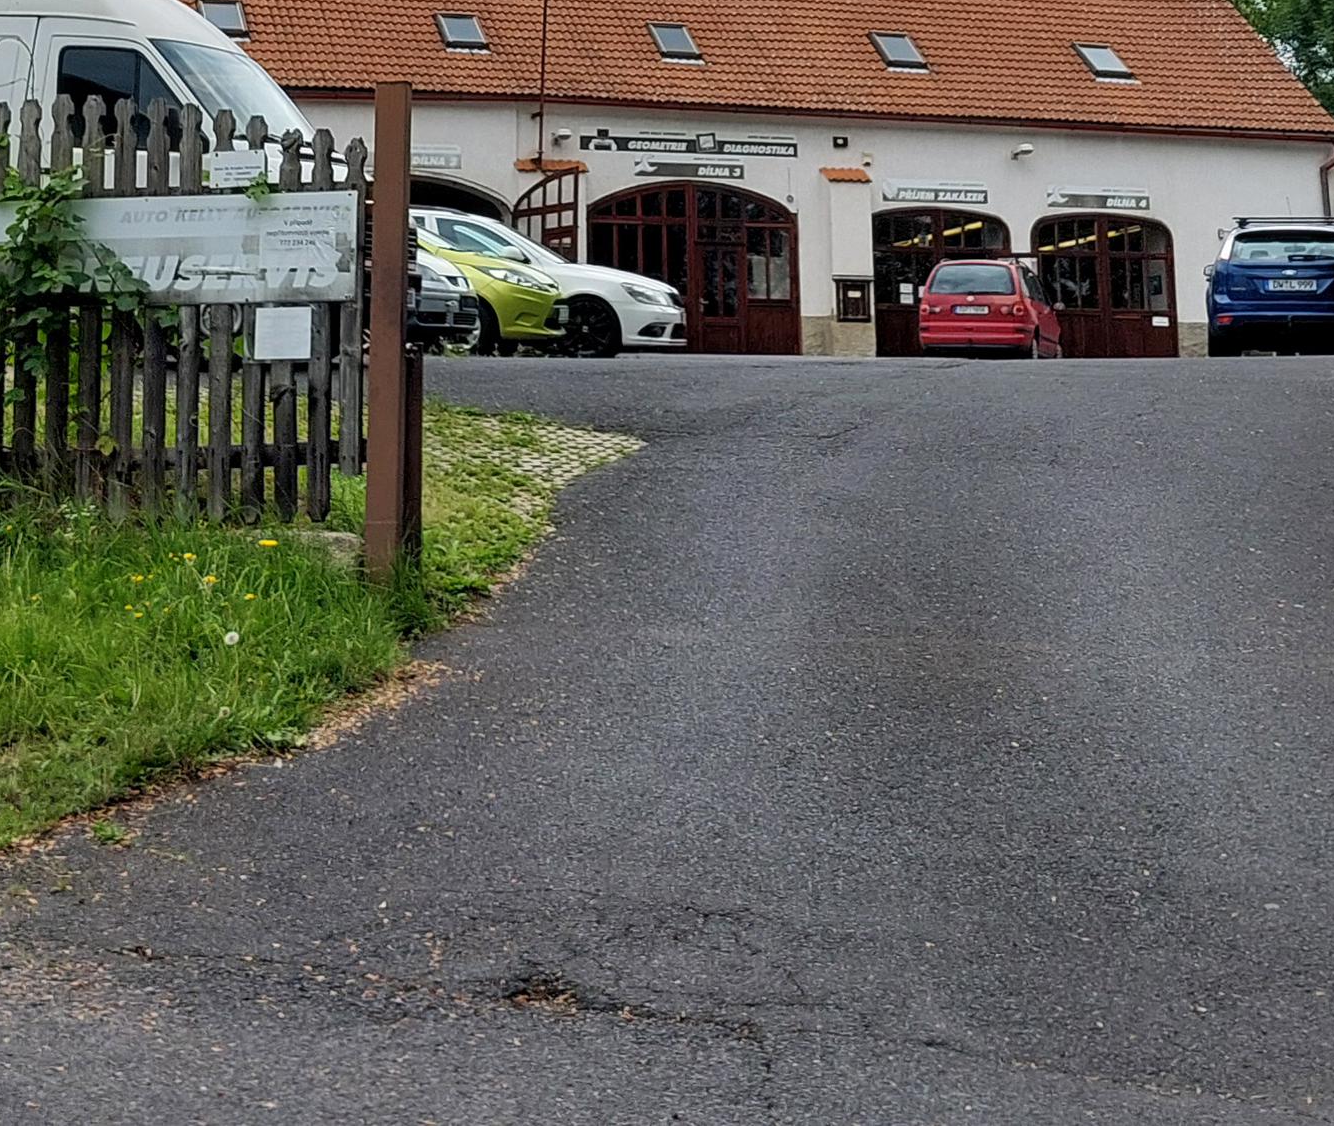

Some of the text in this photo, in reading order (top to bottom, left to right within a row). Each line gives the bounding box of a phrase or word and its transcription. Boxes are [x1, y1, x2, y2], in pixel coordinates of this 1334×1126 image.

[628, 140, 795, 156] GEOMETRIE DIAGNOSTIKA
[697, 165, 741, 177] DÍLNA 3
[937, 191, 986, 202] ZAKÁZEK
[1139, 199, 1147, 208] 4
[120, 210, 168, 224] AUTO
